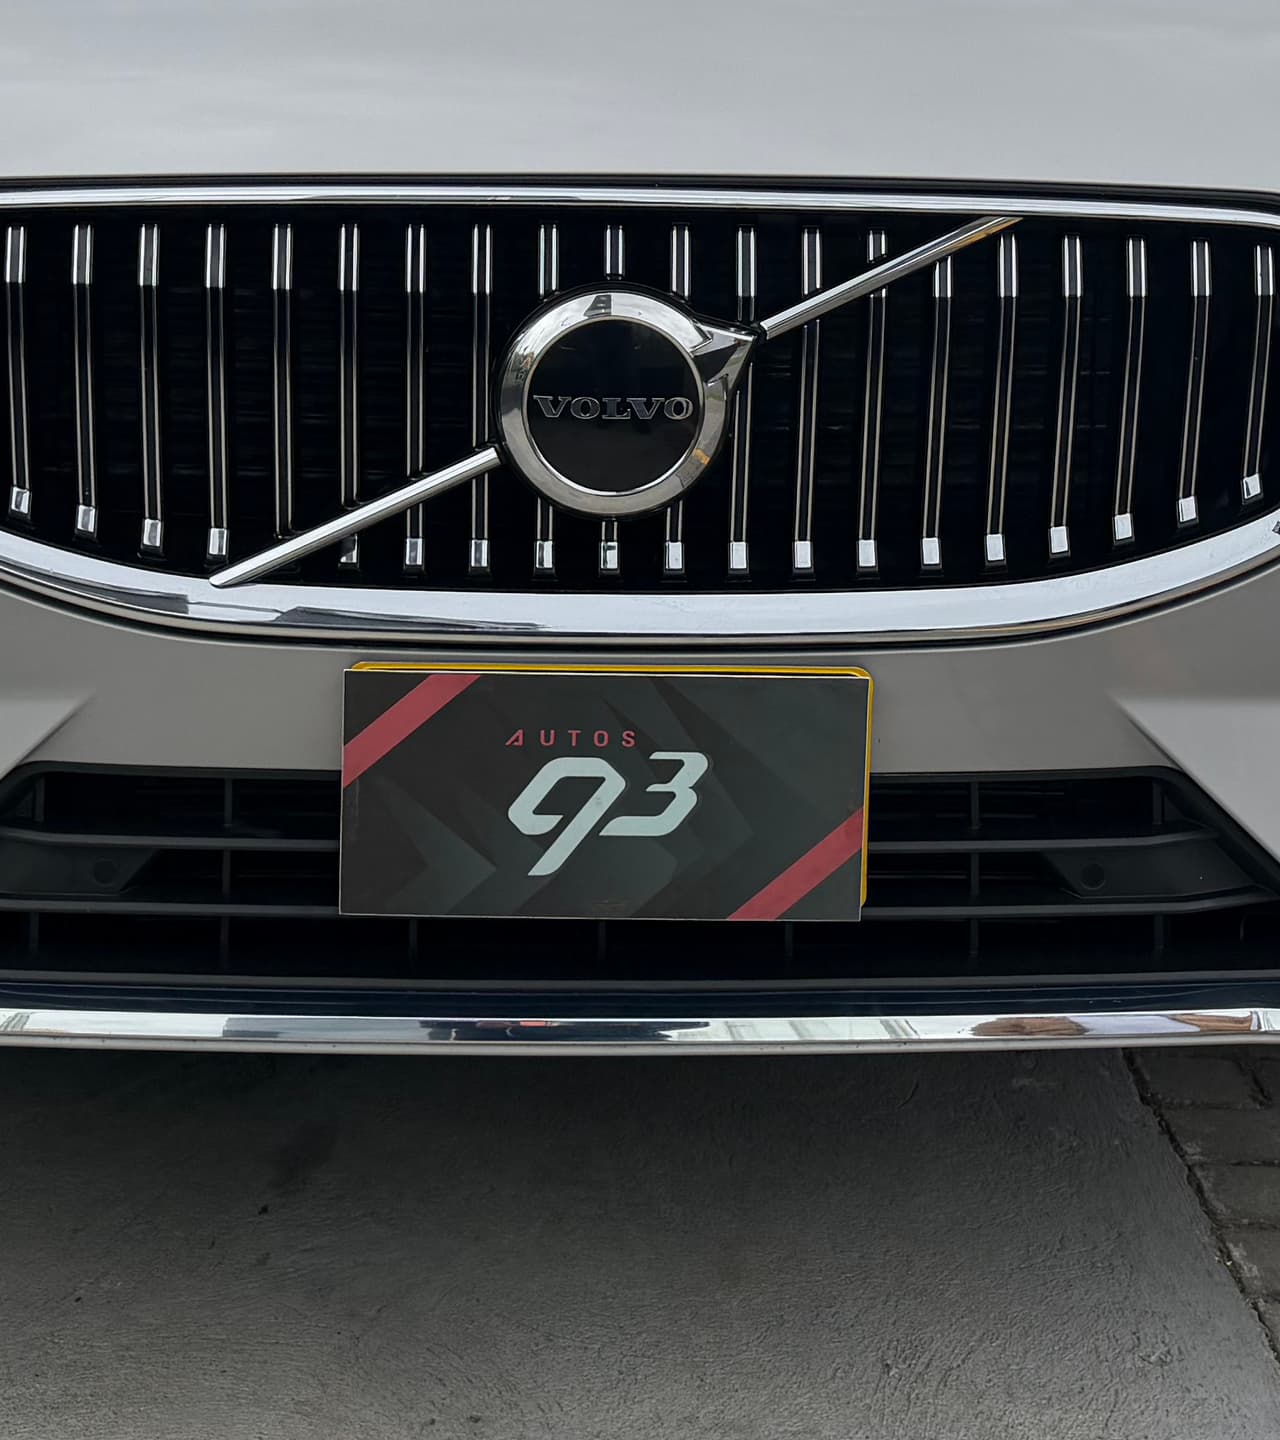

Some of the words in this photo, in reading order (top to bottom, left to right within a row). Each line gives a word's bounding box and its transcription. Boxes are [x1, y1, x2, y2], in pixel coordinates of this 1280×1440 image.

[532, 394, 694, 421] VOLVO
[505, 728, 637, 748] AUTOS
[507, 751, 709, 877] 93
